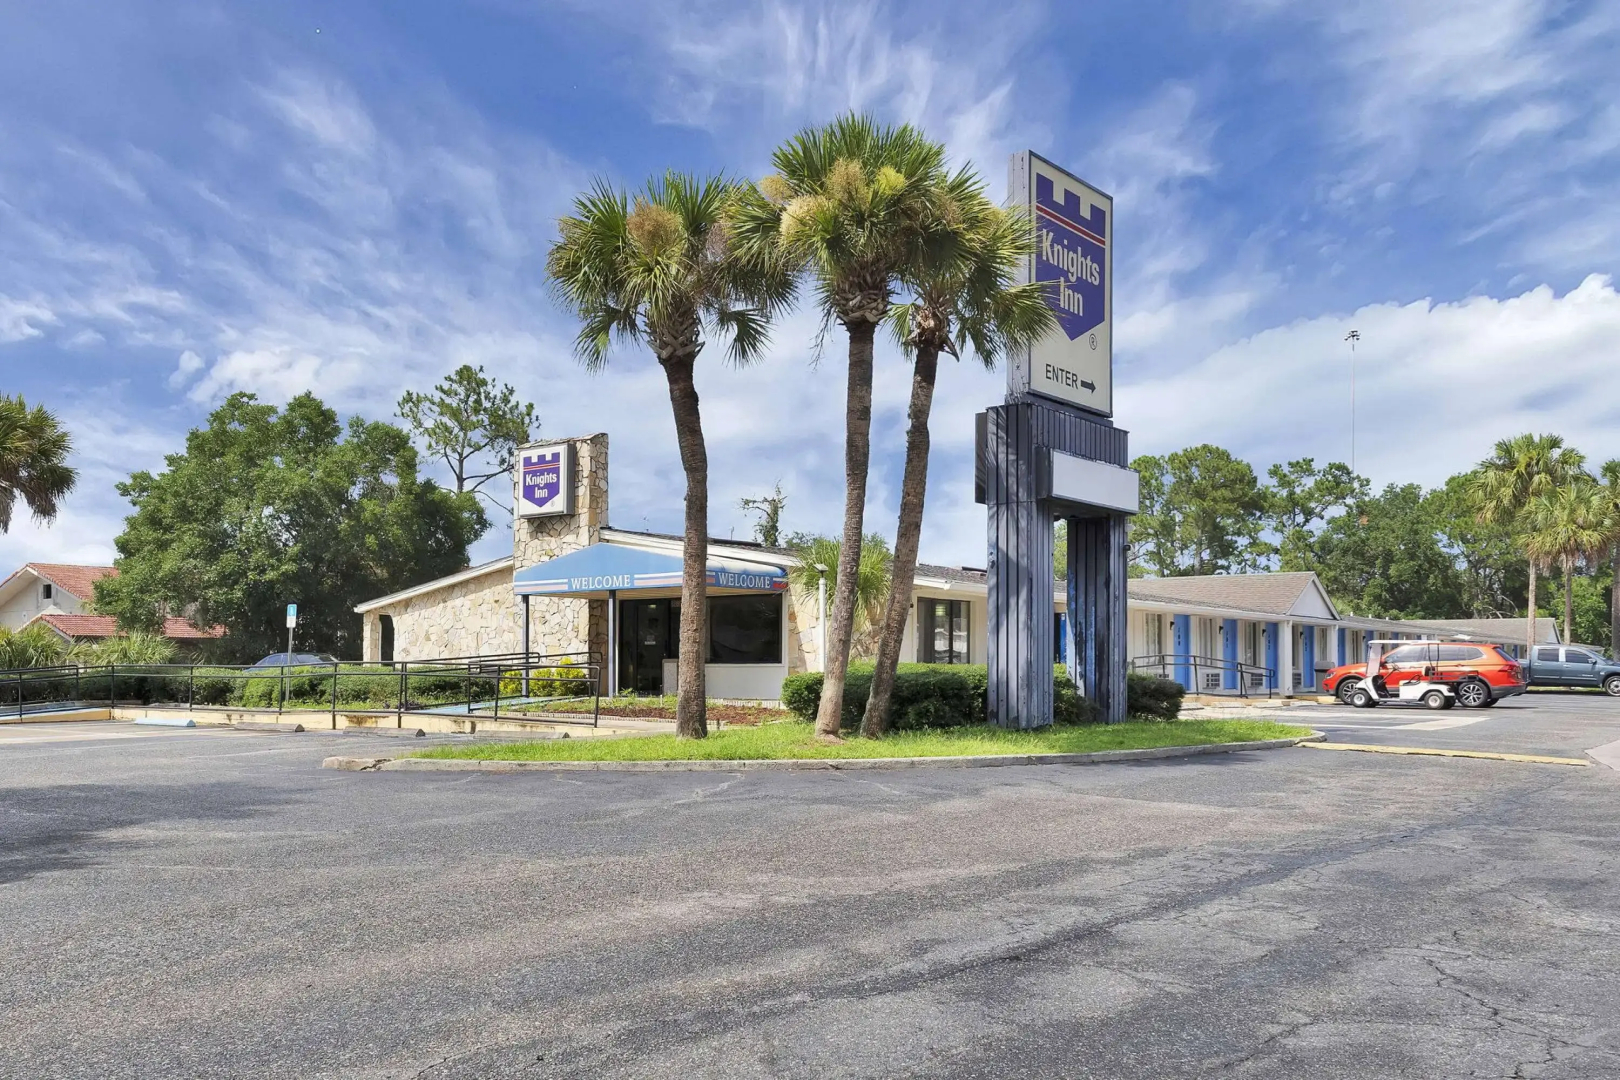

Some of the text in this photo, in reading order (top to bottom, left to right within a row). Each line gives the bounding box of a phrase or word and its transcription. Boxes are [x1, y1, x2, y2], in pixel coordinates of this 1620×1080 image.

[1042, 228, 1100, 286] Knights
[1059, 276, 1083, 317] Inn
[1045, 363, 1079, 390] ENTER
[525, 472, 557, 487] Knights
[534, 487, 548, 499] Inn
[570, 574, 632, 590] WELCOME
[717, 572, 771, 589] WELCOME
